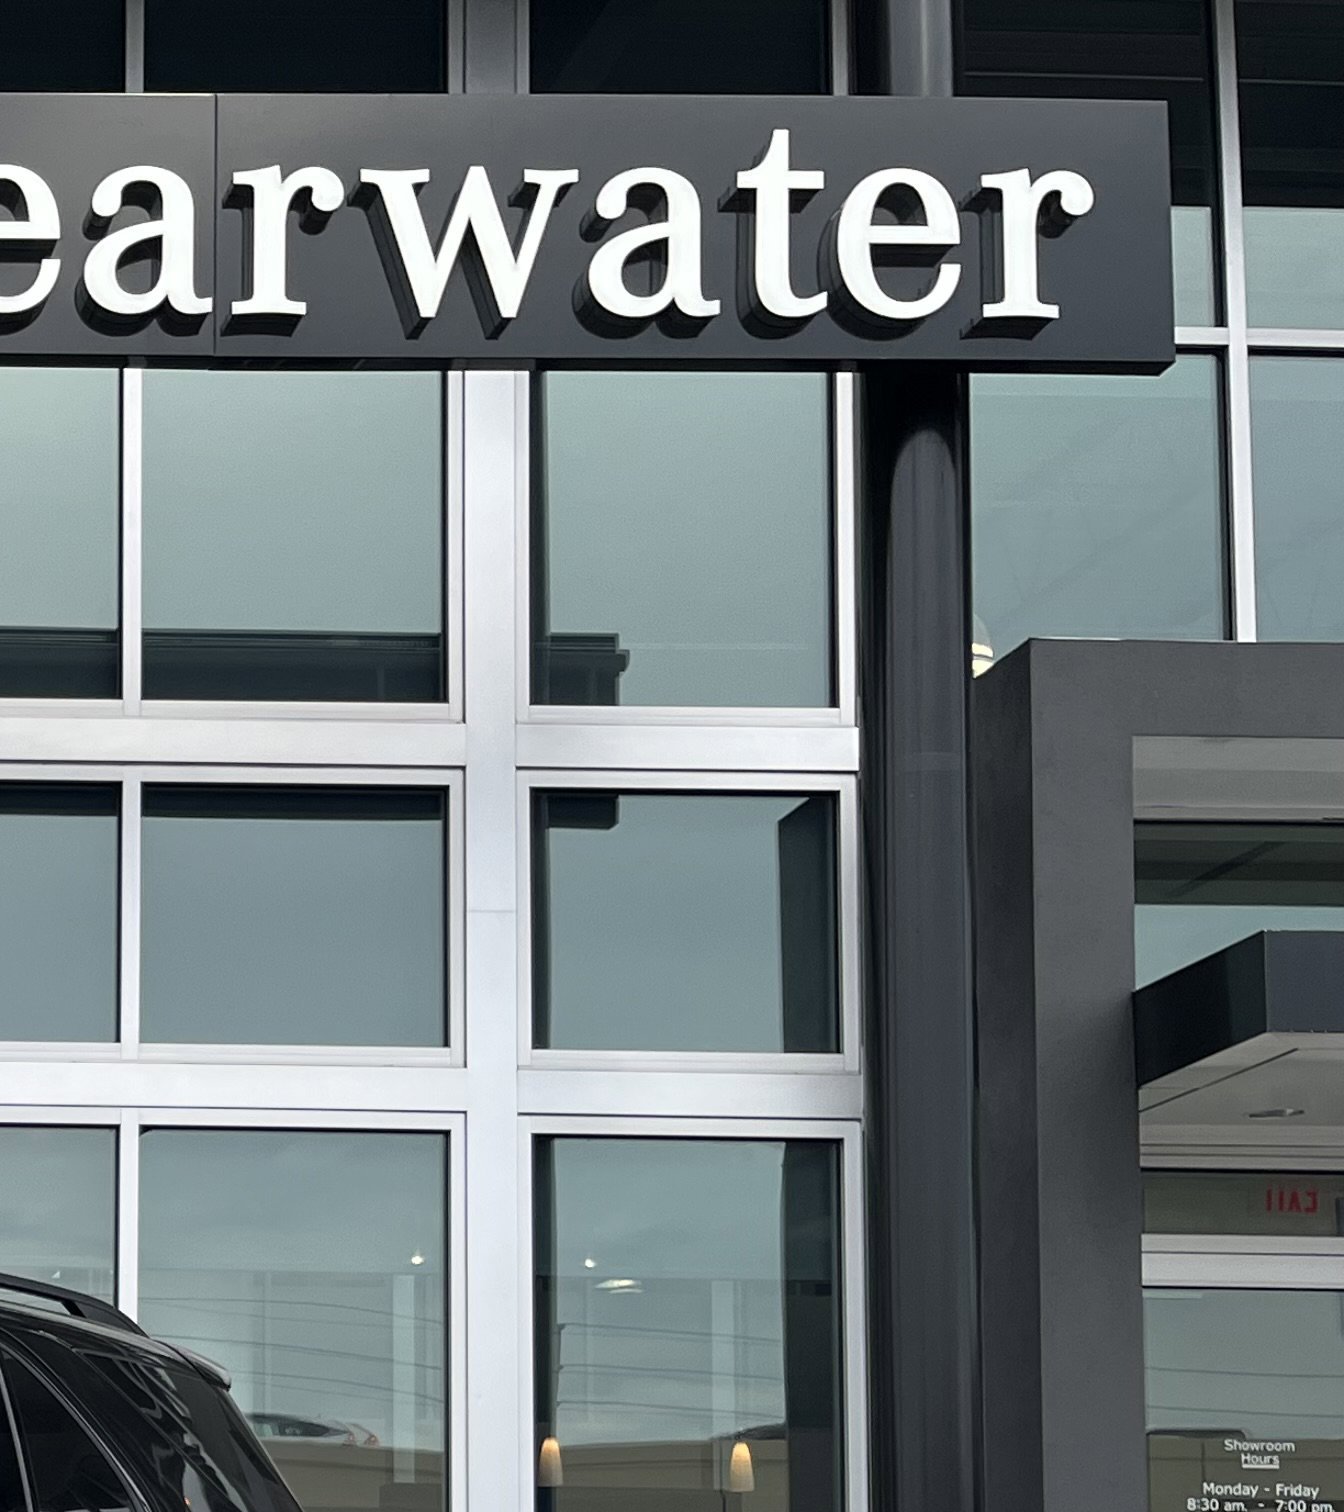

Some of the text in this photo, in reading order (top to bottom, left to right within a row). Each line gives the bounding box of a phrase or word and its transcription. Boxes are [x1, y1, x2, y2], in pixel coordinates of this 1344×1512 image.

[1224, 1438, 1296, 1452] Showroom
[1241, 1452, 1280, 1466] Hours
[1202, 1481, 1259, 1498] Monday
[1275, 1483, 1320, 1499] Friday
[1186, 1497, 1220, 1511] 8:30
[1223, 1501, 1247, 1512] am.
[1274, 1499, 1308, 1512] 7:00
